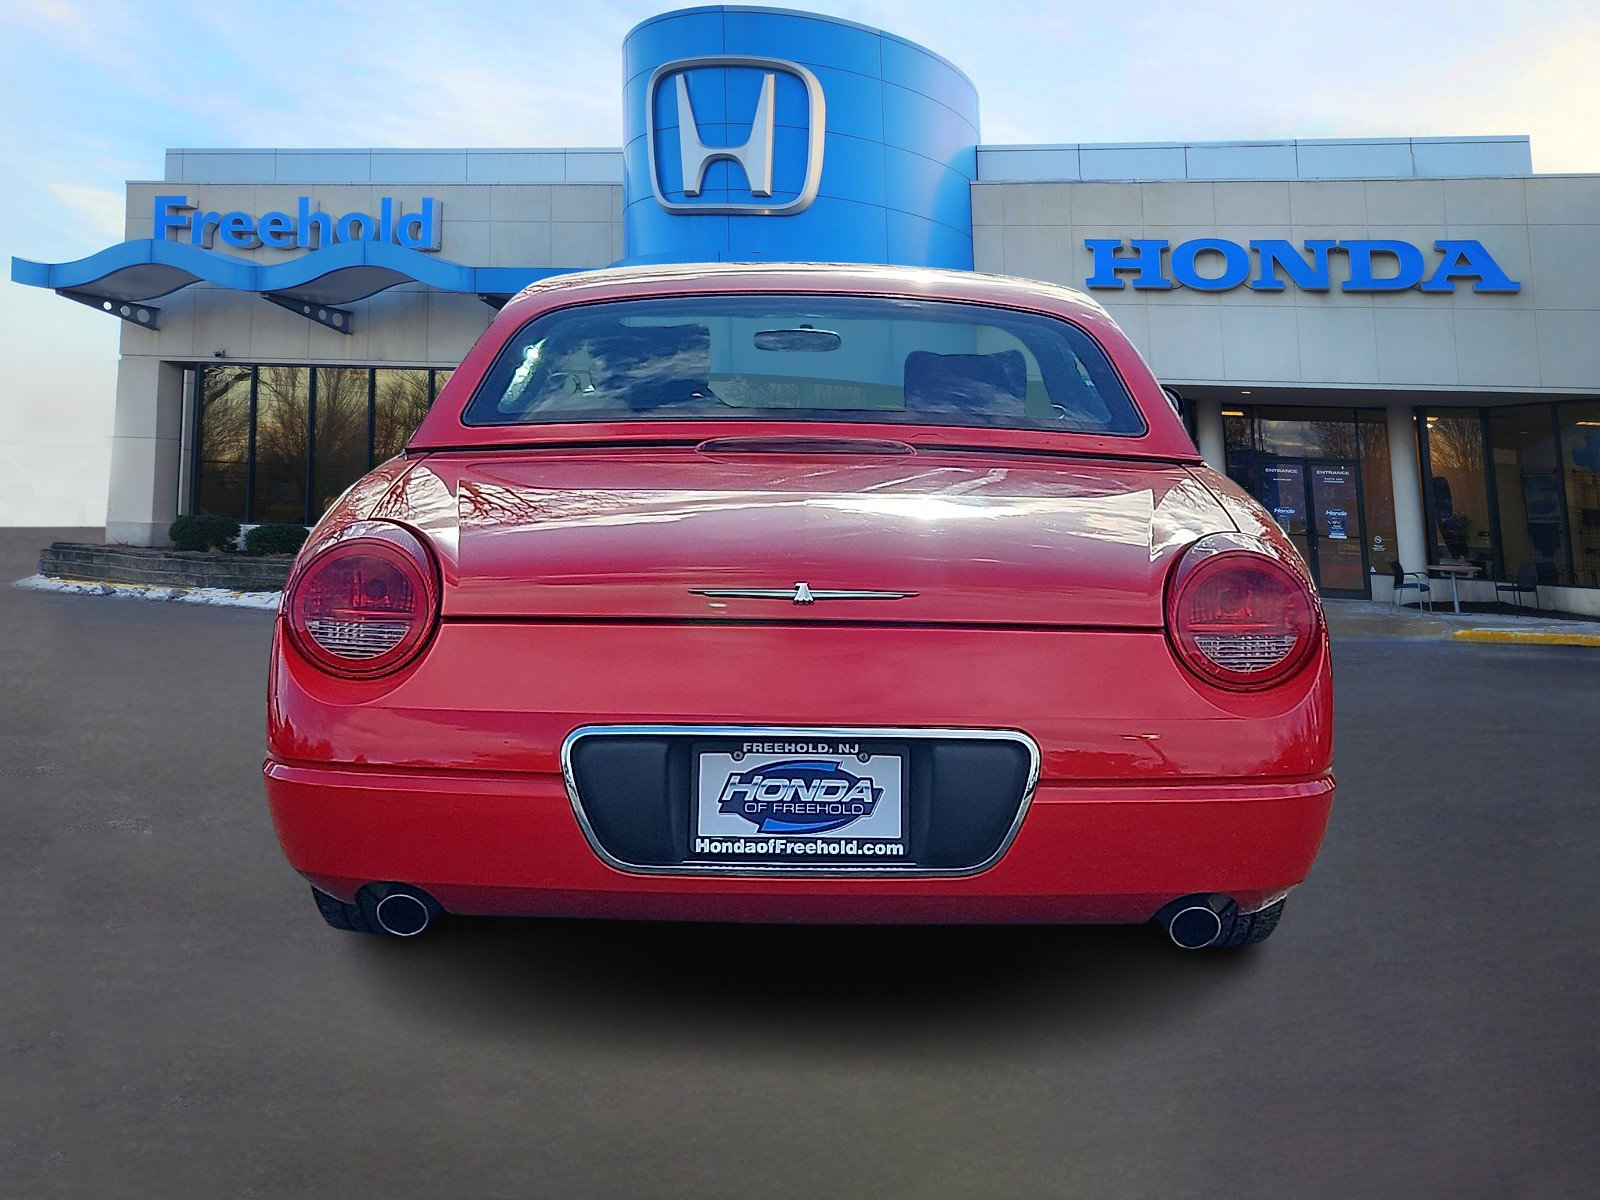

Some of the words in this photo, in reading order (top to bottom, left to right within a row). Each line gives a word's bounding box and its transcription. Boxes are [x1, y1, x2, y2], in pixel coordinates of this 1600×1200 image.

[153, 195, 438, 250] Freehold
[1084, 238, 1522, 293] HONDA
[743, 742, 833, 754] FREEHOLD,
[838, 743, 860, 754] NJ
[721, 775, 874, 803] HONDA
[744, 802, 768, 814] OF
[773, 803, 865, 815] FREEHOLD
[695, 838, 904, 855] HondaofFreehold.com
